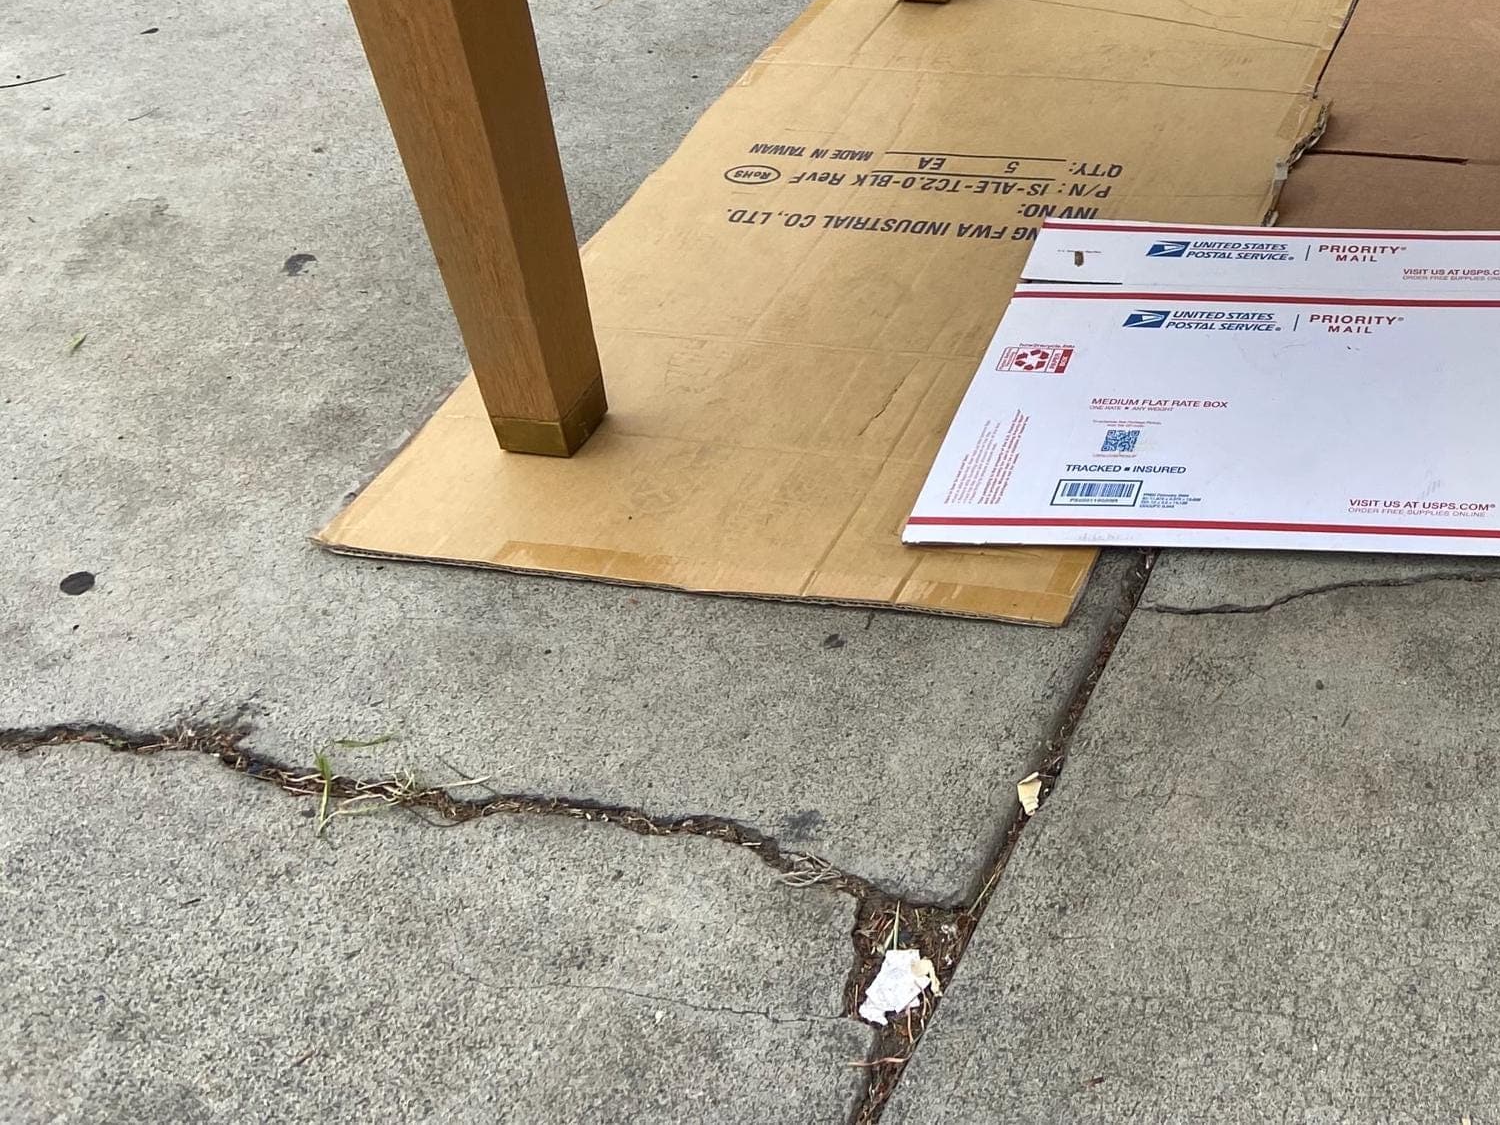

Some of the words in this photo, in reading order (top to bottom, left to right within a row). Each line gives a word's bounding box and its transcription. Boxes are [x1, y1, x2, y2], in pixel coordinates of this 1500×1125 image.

[749, 143, 806, 157] TAIWAN
[810, 147, 830, 159] IN
[830, 149, 875, 162] MADE
[917, 157, 946, 171] EA
[1004, 161, 1019, 174] 5
[734, 169, 773, 180] RoHS
[1017, 203, 1057, 218] NO:
[1057, 205, 1099, 219] INV
[727, 209, 774, 225] LTD.
[823, 214, 951, 236] INDUSTRIAL
[956, 223, 1003, 240] FWA
[1192, 241, 1242, 249] UNITED
[1242, 242, 1288, 250] STATES
[1185, 251, 1233, 259] POSTAL
[1335, 254, 1377, 263] MAIL
[1430, 268, 1445, 276] US
[1447, 268, 1461, 276] AT
[1173, 311, 1225, 319] UNITED
[1226, 312, 1275, 321] STATES
[1165, 321, 1216, 330] POSTAL
[1327, 325, 1373, 334] MAIL
[1091, 398, 1140, 406] MEDIUM
[1141, 399, 1171, 407] FLAT
[1171, 400, 1201, 408] RATE
[1202, 400, 1229, 408] BOX
[1065, 464, 1122, 473] TRACKED
[1132, 465, 1187, 474] INSURED
[1349, 498, 1380, 507] VISIT
[1383, 499, 1401, 508] US
[1403, 500, 1420, 509] AT
[1452, 510, 1487, 518] ONLINE
